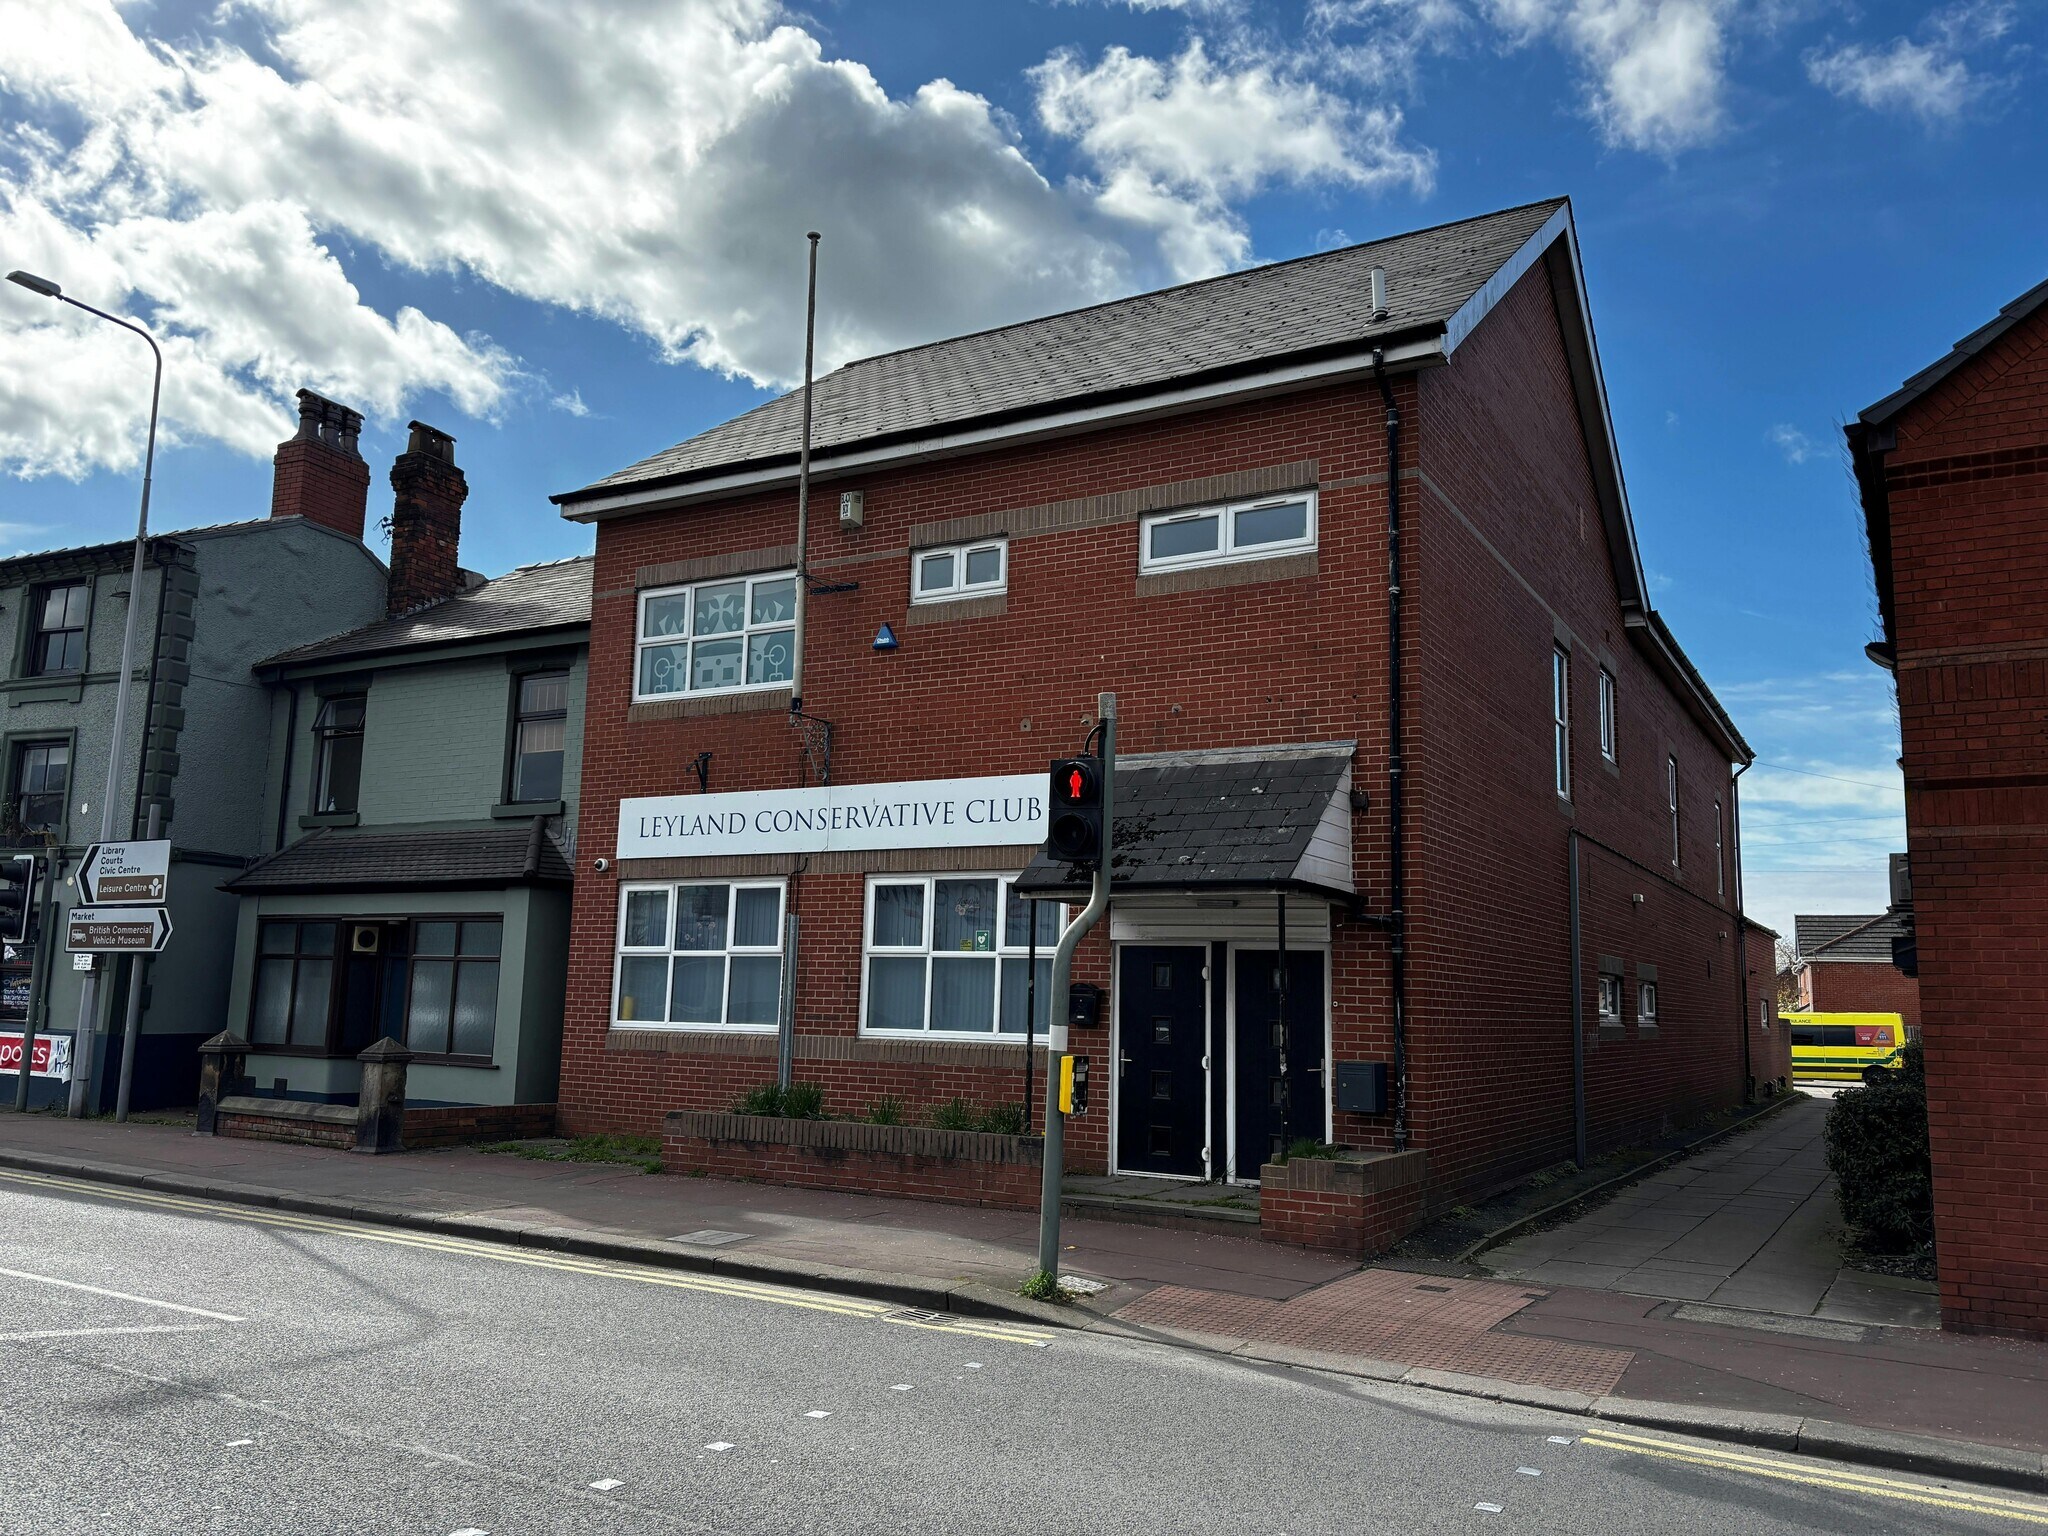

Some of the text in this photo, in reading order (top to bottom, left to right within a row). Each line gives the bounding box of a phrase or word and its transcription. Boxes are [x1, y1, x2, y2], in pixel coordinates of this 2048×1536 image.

[639, 797, 1042, 838] LEYLAND CONSERVATIVE CLUB
[102, 847, 125, 855] Library
[101, 857, 123, 865] Courts
[100, 866, 141, 875] Civic Centre
[100, 883, 147, 893] Leisure Centre
[71, 912, 95, 920] Market
[89, 925, 152, 934] British Commercial
[93, 936, 145, 944] Vehicle Museum
